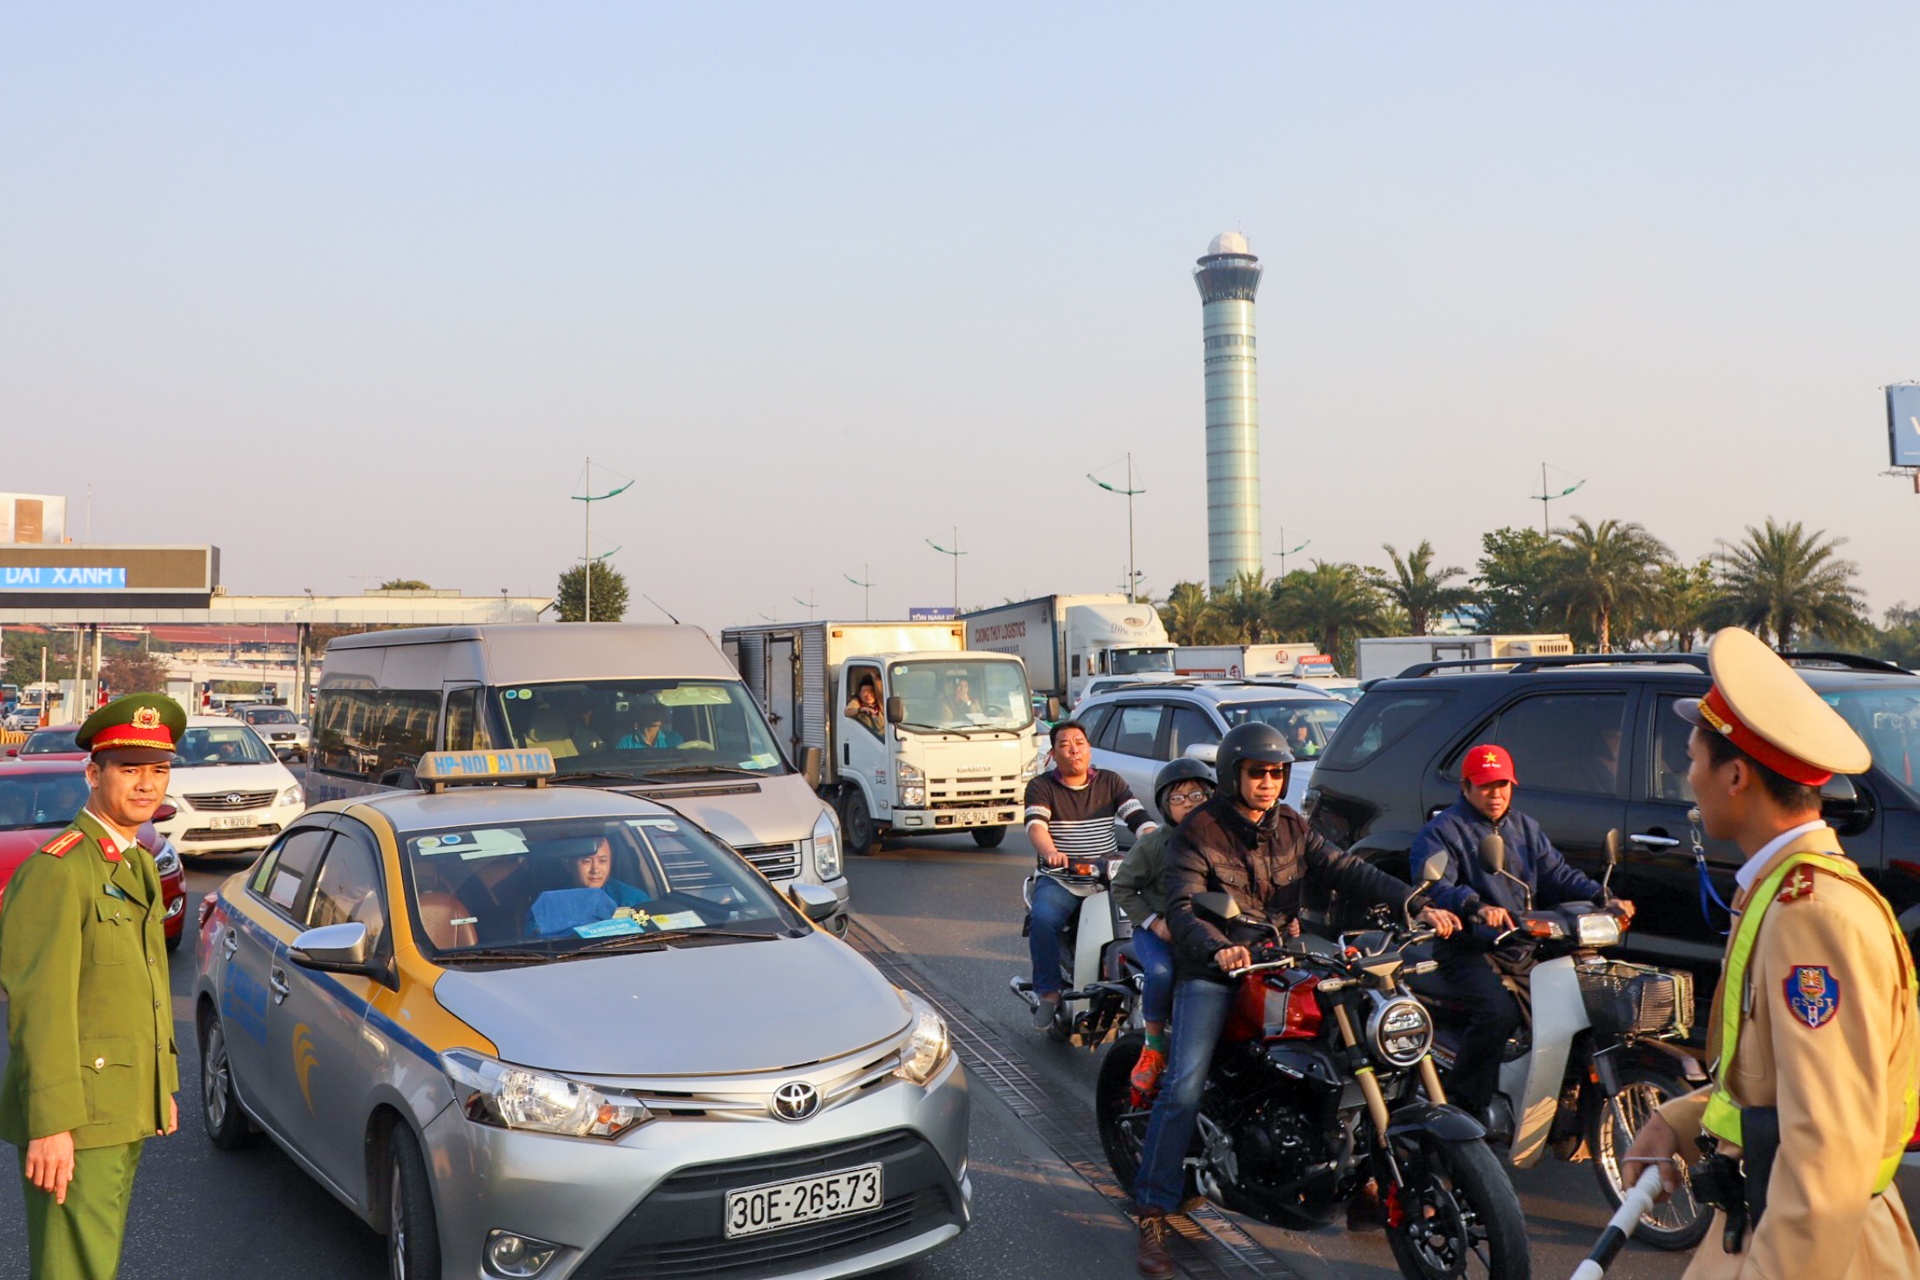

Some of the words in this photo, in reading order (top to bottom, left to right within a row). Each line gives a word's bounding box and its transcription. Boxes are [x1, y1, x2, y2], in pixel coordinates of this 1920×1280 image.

[51, 567, 112, 584] XANH
[1002, 620, 1026, 640] LOGISTICS
[515, 753, 551, 772] TAXI
[1792, 998, 1834, 1008] CSGT
[733, 1172, 876, 1230] 30E-265.73
